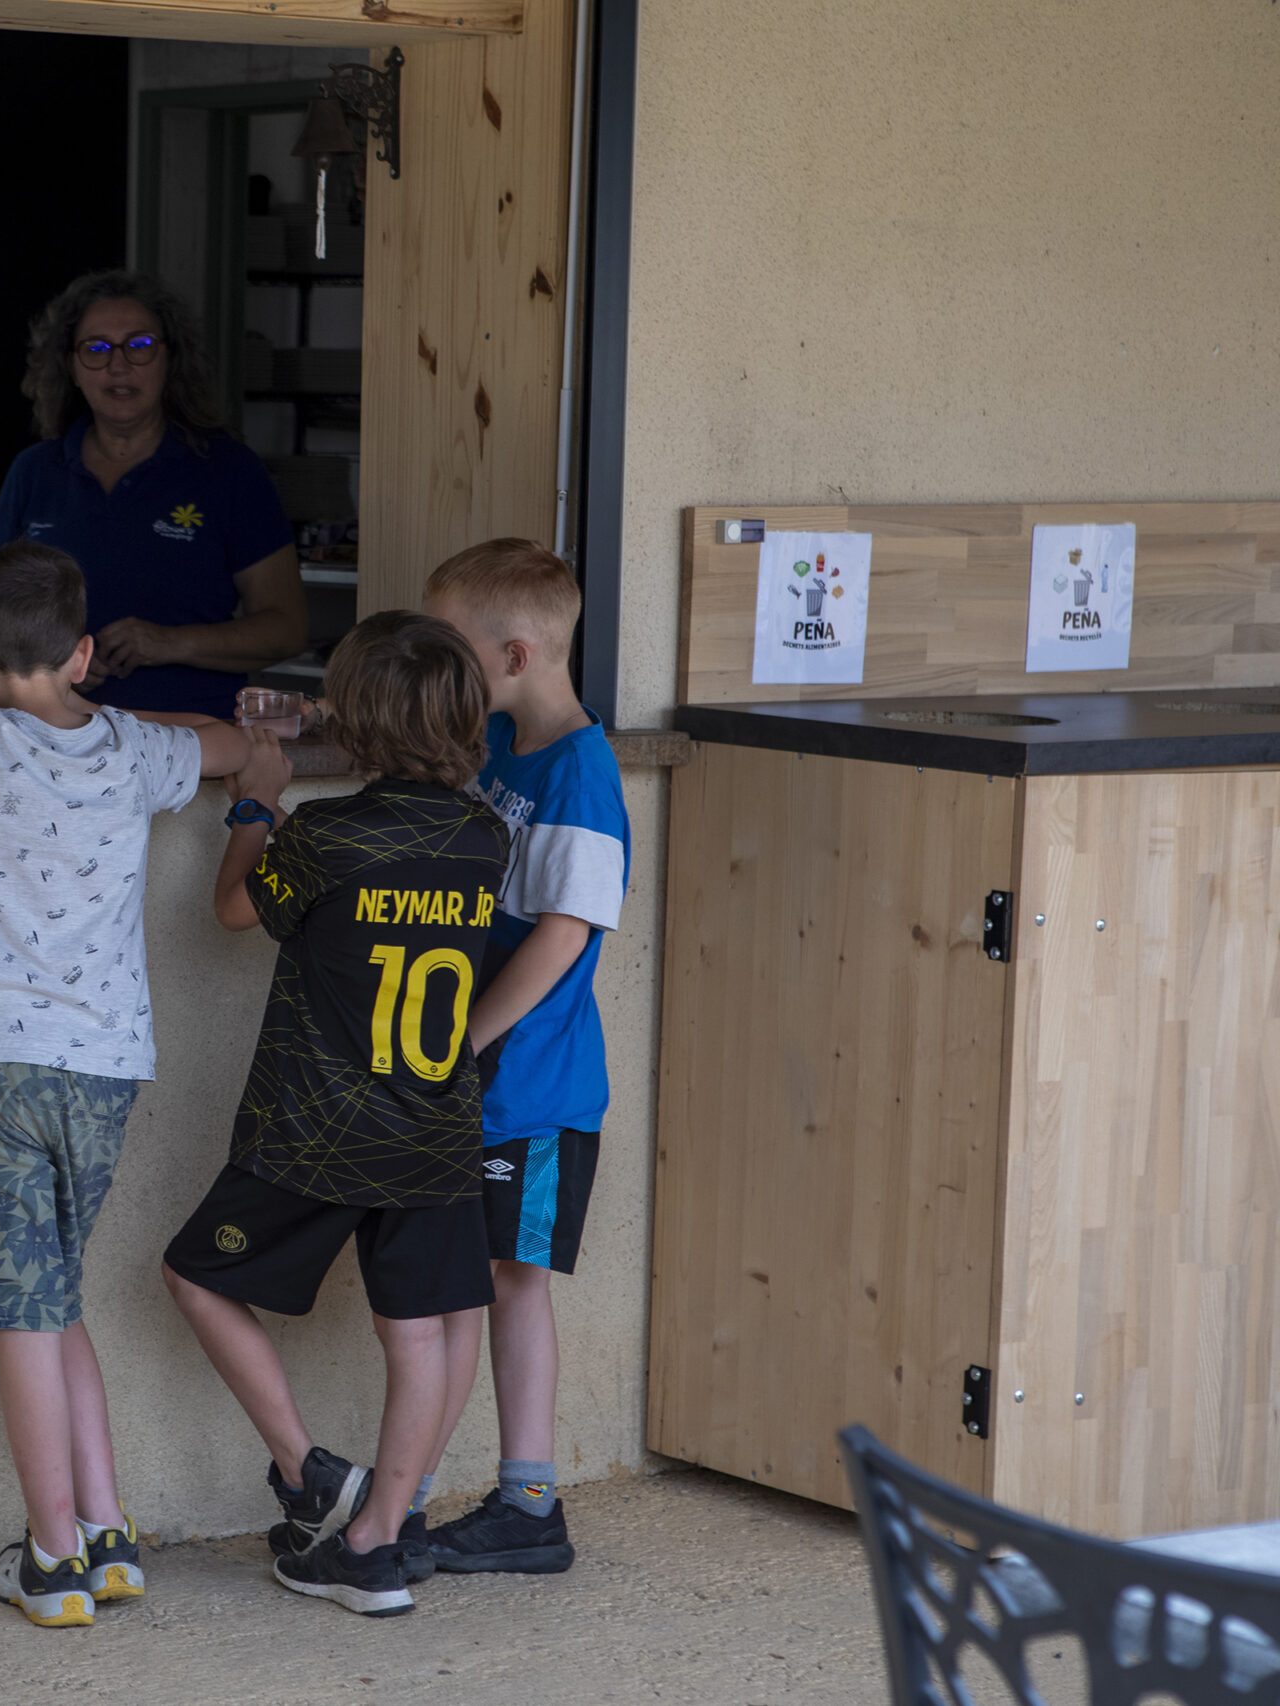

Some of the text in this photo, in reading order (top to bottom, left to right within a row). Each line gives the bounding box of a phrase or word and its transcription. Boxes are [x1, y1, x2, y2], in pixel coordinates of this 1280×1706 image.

[794, 618, 834, 640] PEÑA
[1063, 608, 1101, 629] PEÑA
[355, 887, 464, 926] NEYMAR
[368, 944, 473, 1082] 10
[484, 1172, 512, 1182] umbro
